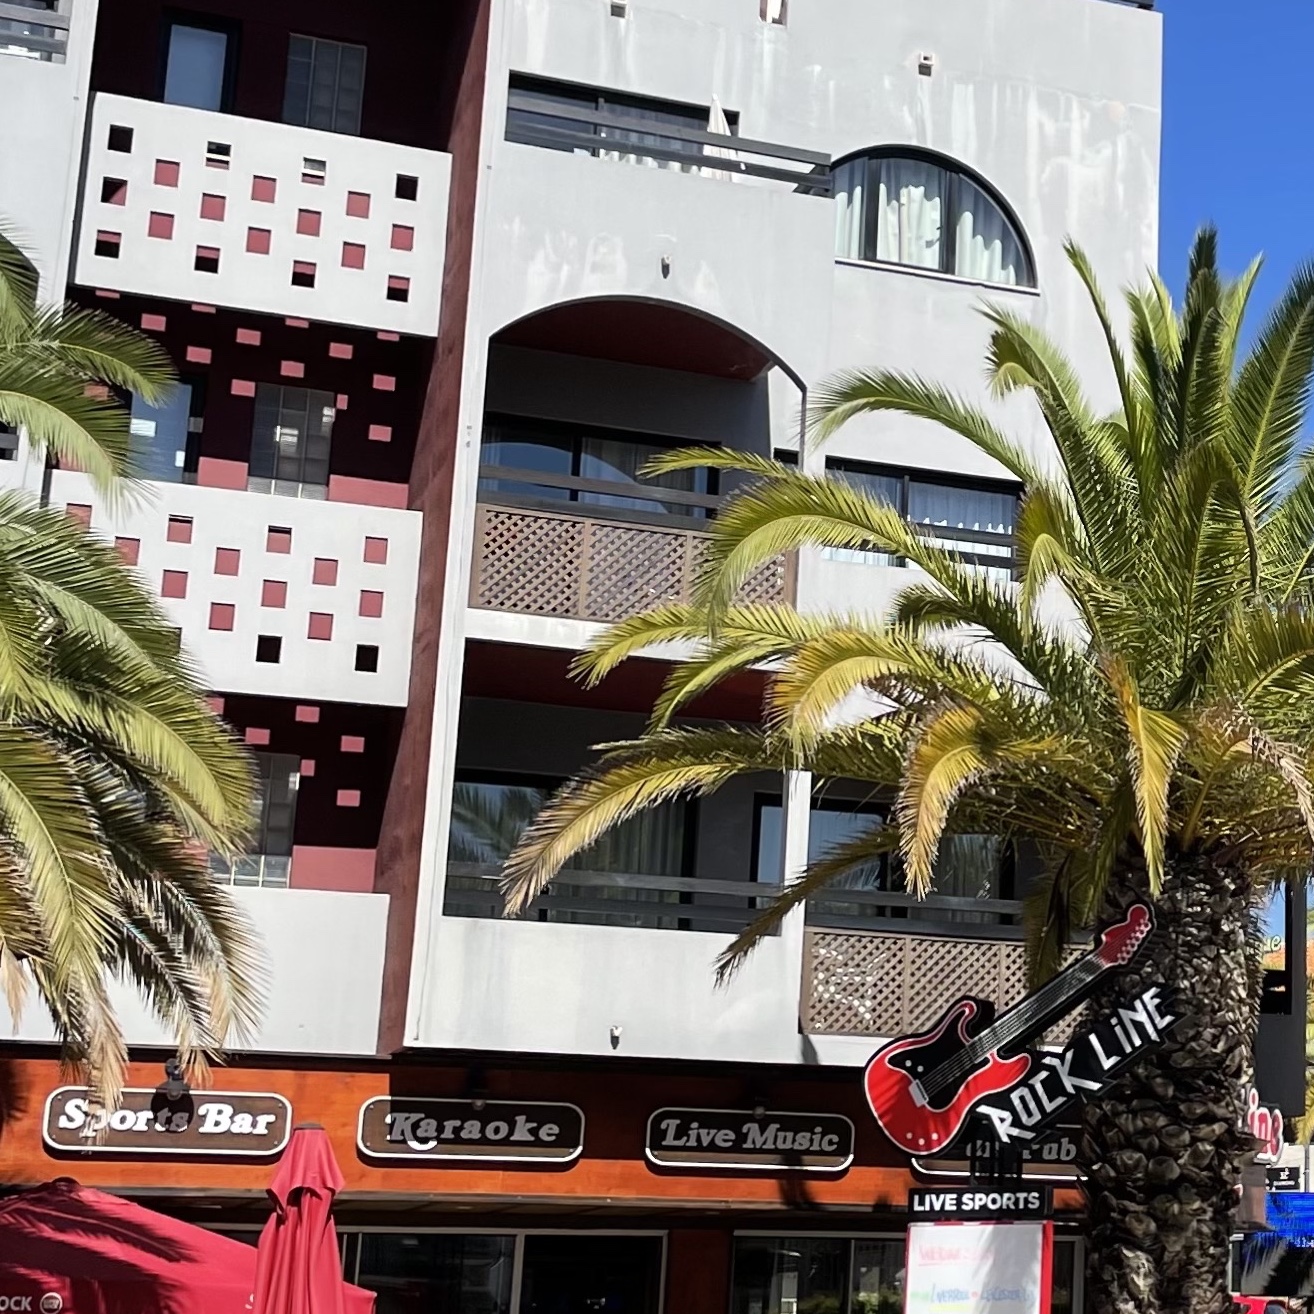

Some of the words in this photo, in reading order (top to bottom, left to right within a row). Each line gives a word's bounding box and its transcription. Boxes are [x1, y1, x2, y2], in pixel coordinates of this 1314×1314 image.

[976, 1048, 1103, 1144] ROCK
[198, 1102, 276, 1135] Bar
[384, 1112, 560, 1151] Karaoke
[660, 1119, 736, 1147] Live
[742, 1122, 840, 1151] Music
[913, 1193, 957, 1211] LIVE
[961, 1192, 1041, 1210] SPORTS
